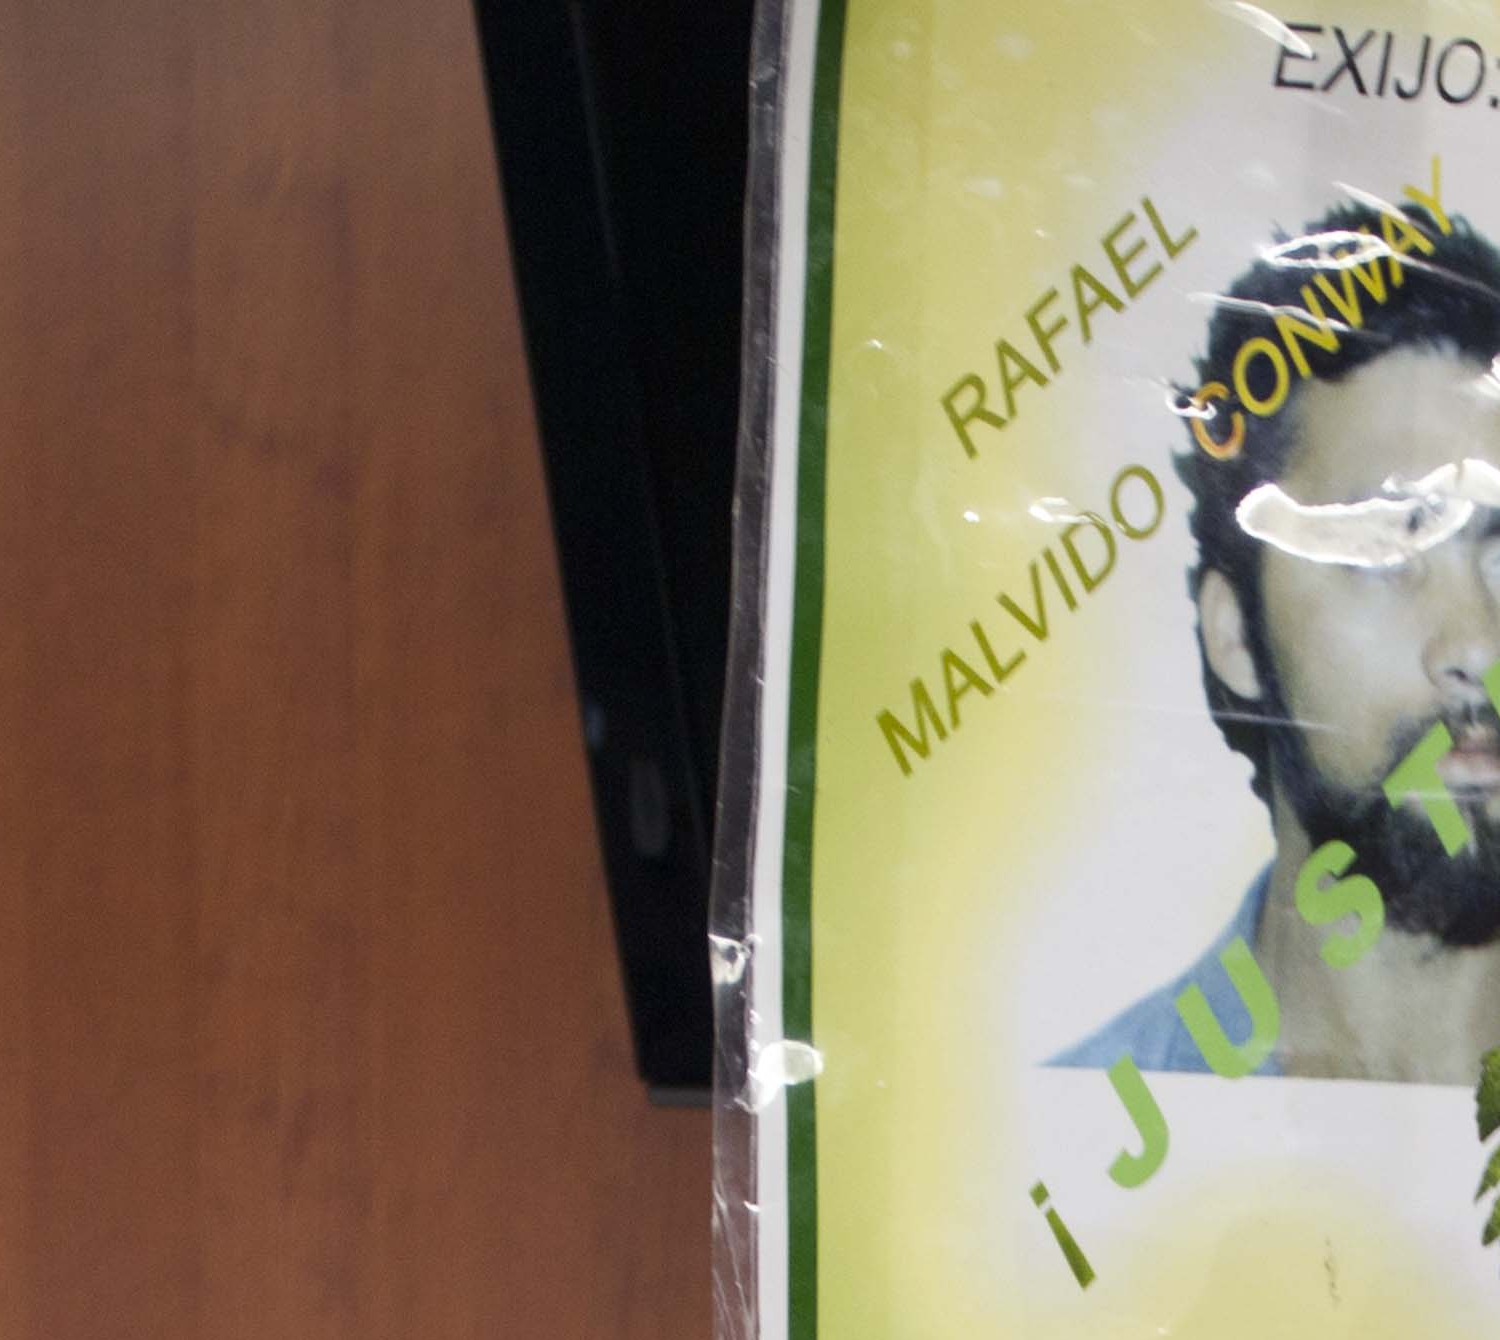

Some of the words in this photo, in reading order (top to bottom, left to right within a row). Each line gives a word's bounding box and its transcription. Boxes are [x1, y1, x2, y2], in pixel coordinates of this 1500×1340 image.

[875, 464, 1165, 776] MALVIDO
[1191, 155, 1453, 460] CONWAY
[940, 197, 1198, 459] RAFAEL
